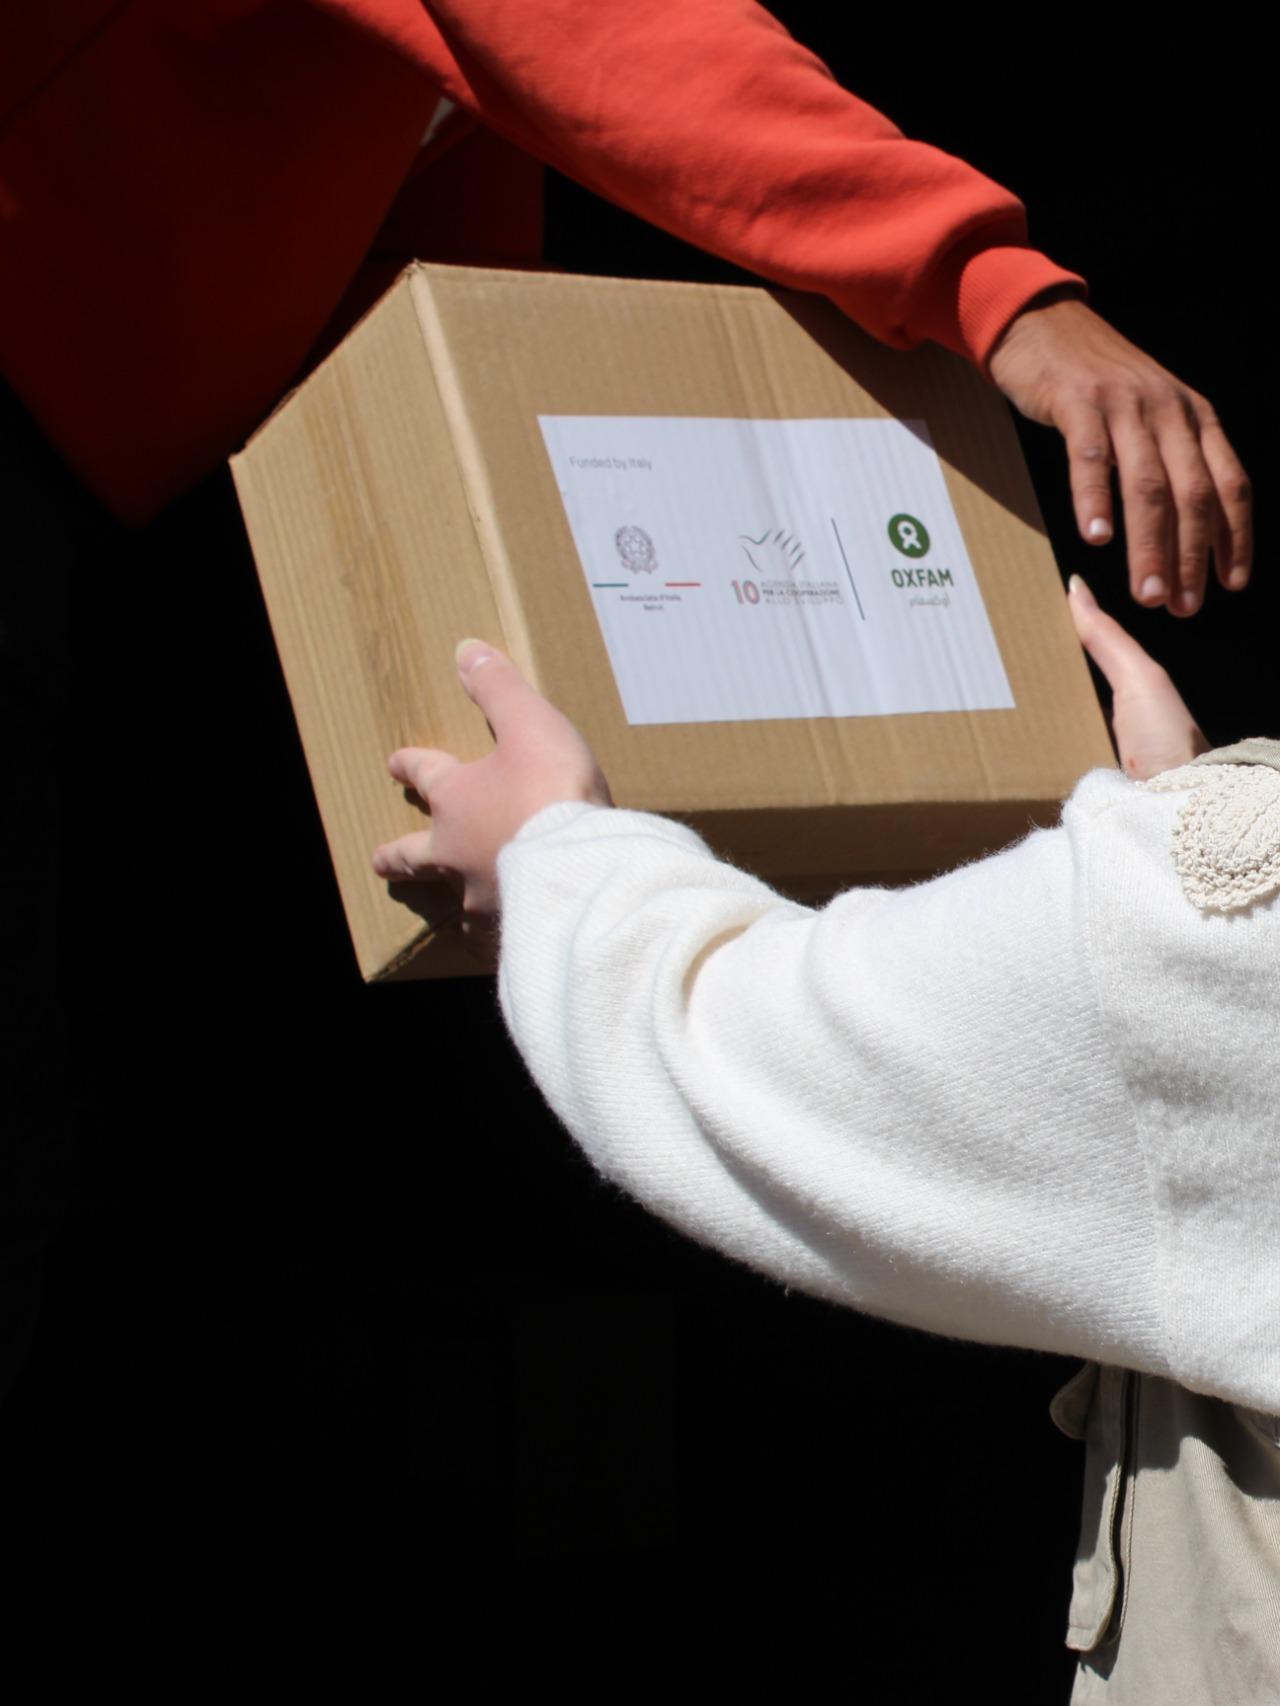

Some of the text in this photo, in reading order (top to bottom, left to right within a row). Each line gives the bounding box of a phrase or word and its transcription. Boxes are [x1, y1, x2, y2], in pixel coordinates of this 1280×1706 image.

[568, 456, 652, 472] Funded by Italy
[891, 568, 955, 588] OXFAM
[731, 579, 760, 605] 10
